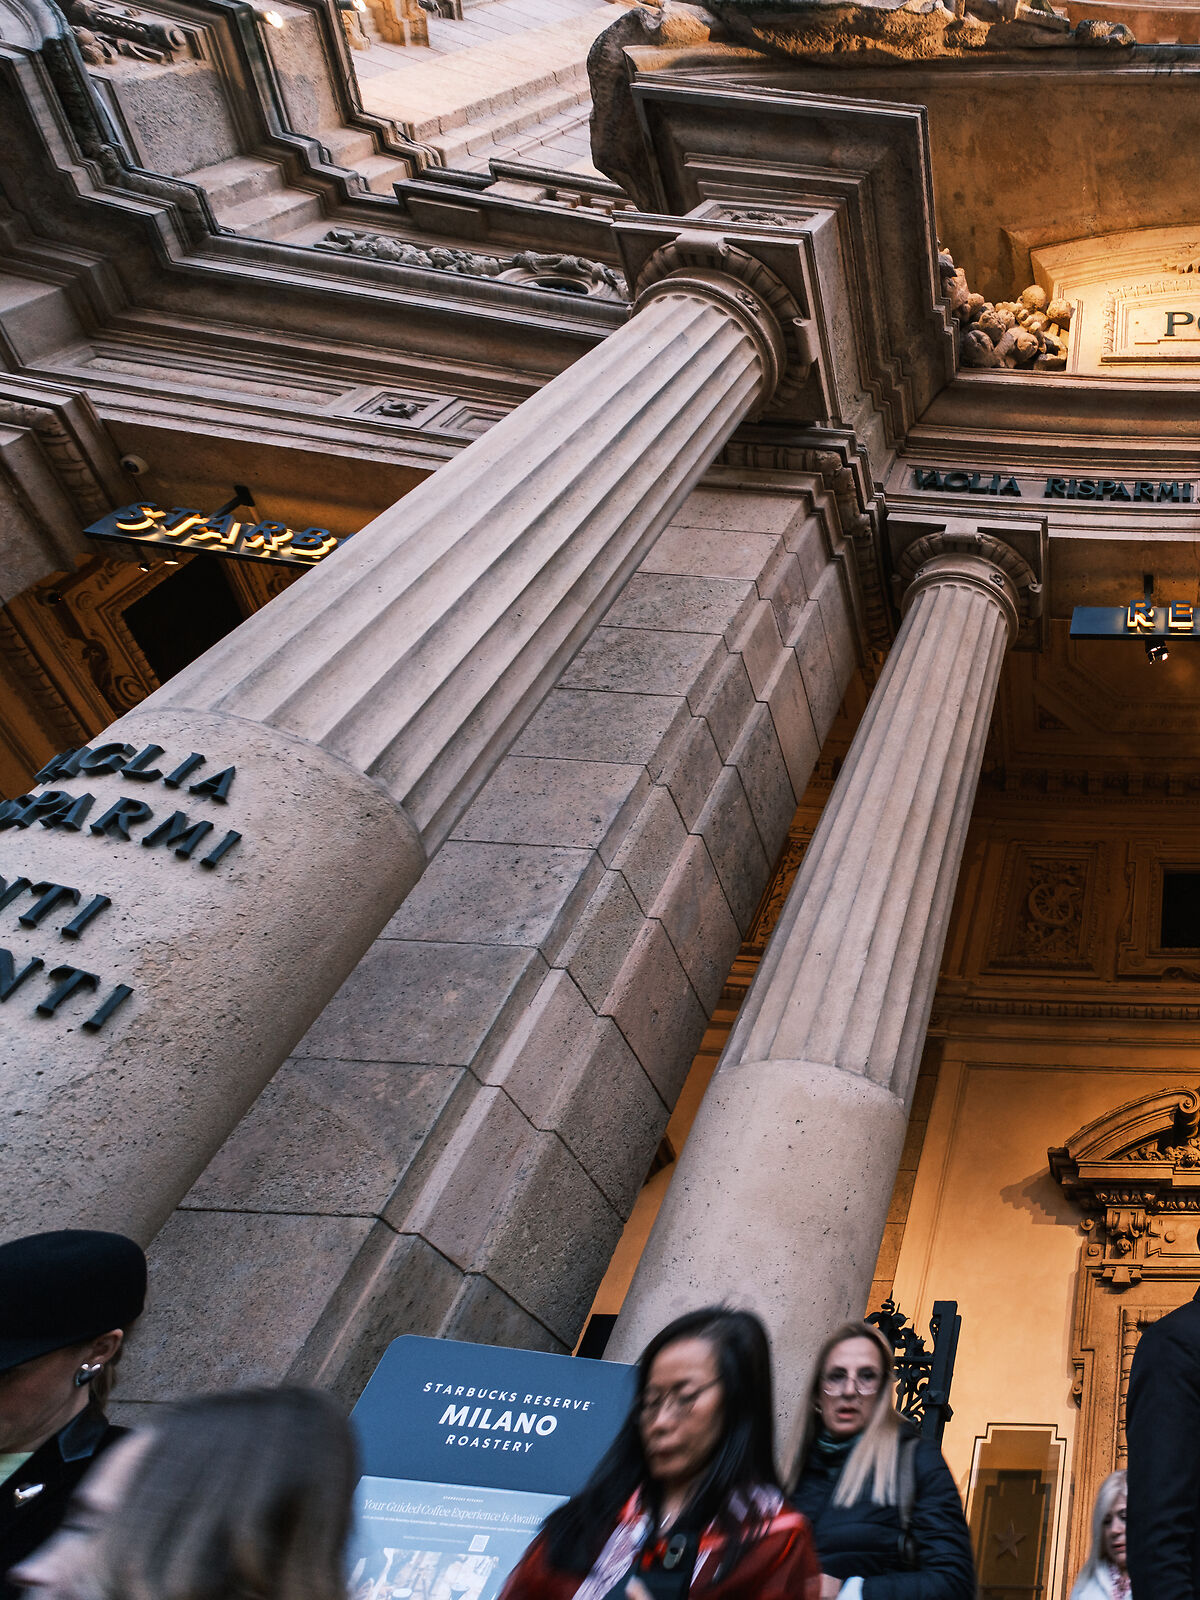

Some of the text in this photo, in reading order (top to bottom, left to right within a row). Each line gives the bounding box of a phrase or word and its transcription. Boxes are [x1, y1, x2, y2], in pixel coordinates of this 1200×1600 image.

[1044, 477, 1192, 502] RISPARMI
[114, 501, 355, 556] STARB
[423, 1382, 591, 1411] STARBUCKS RESERVE
[438, 1404, 558, 1436] MILANO
[445, 1434, 534, 1453] ROASTERY
[363, 1499, 386, 1510] Your
[386, 1501, 421, 1514] Guided
[420, 1504, 451, 1517] Coffee
[450, 1507, 501, 1521] Experience
